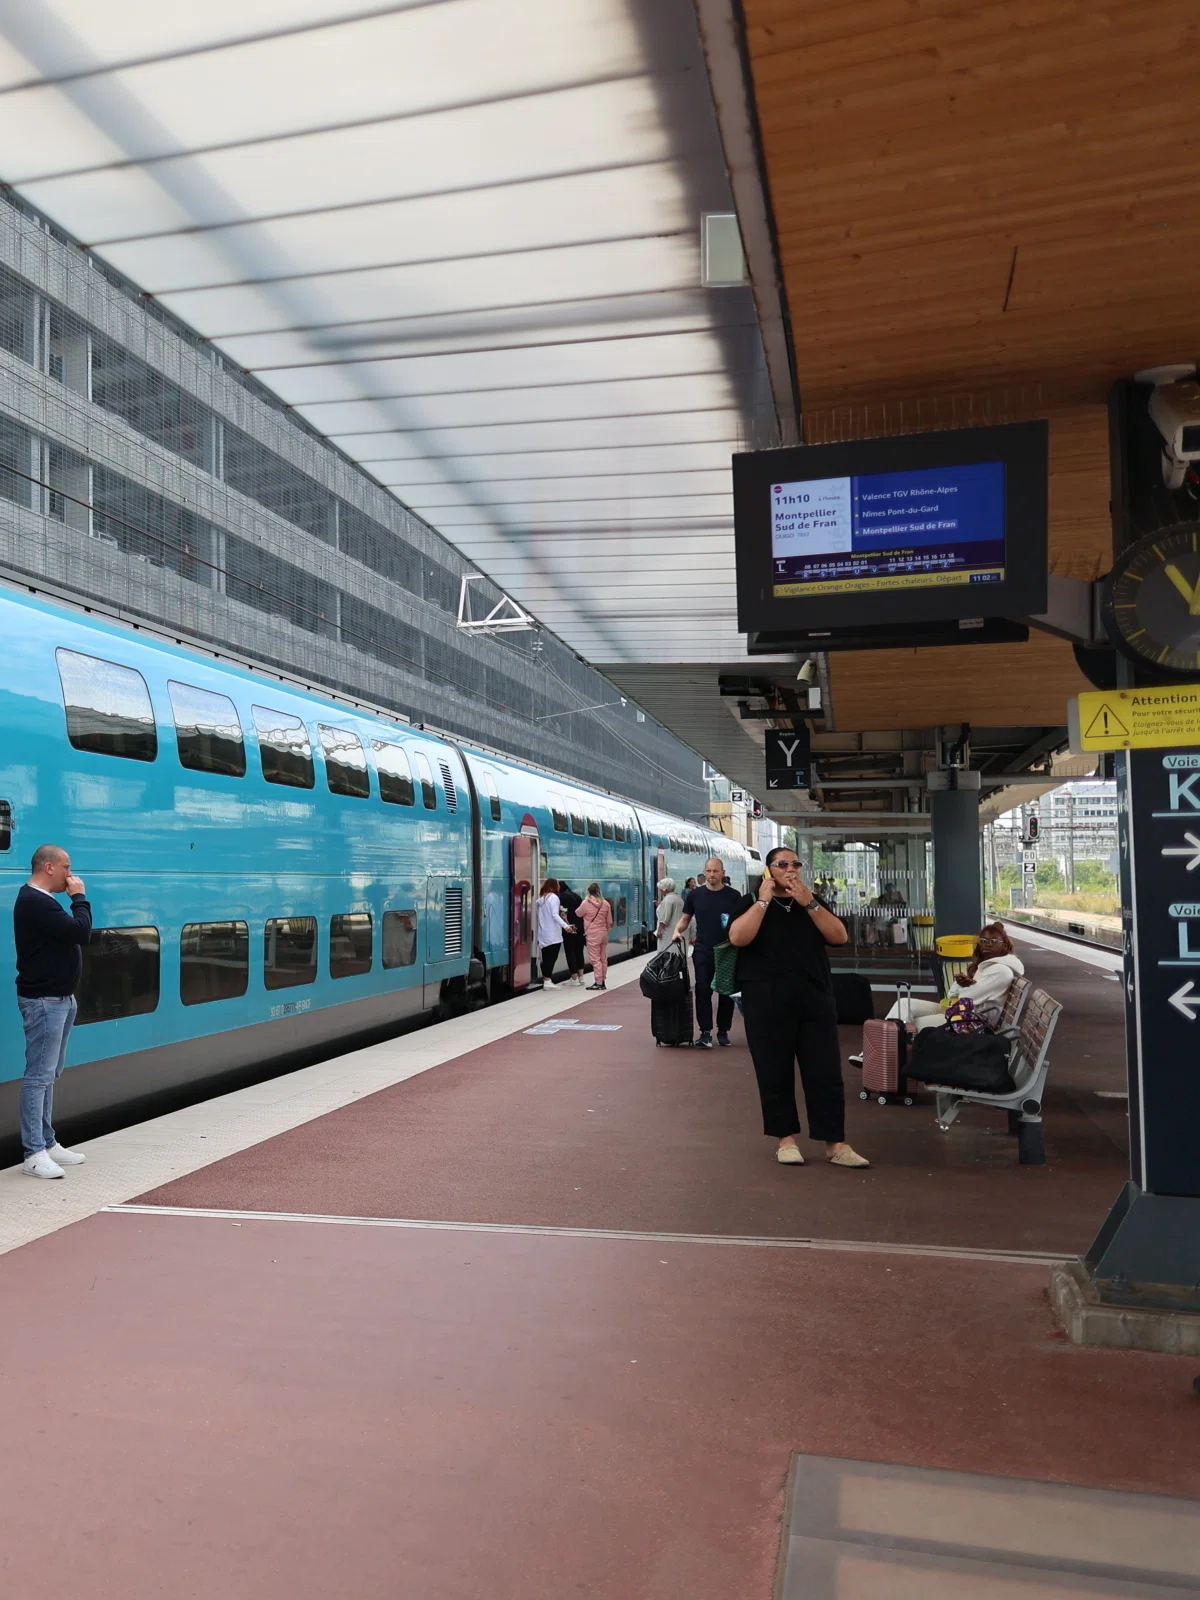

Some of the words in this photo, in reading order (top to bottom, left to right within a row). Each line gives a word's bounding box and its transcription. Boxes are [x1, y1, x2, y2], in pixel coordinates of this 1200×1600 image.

[910, 486, 958, 496] Rhône-Alpes
[775, 494, 810, 505] 11h10
[775, 508, 837, 520] Montpellier
[862, 510, 886, 518] Nîmes
[888, 504, 939, 516] Pont-du-Gard
[775, 522, 795, 532] Sud
[798, 522, 810, 530] de
[813, 520, 837, 528] Fran
[862, 526, 908, 535] Montpellier
[910, 523, 925, 531] Sud
[938, 520, 956, 528] Fran
[778, 564, 785, 572] L
[784, 586, 816, 594] Vigilance
[936, 575, 962, 584] Départ
[1132, 694, 1198, 706] Attention
[1132, 728, 1160, 737] jusqu'à
[777, 740, 800, 766] Y
[1168, 756, 1198, 767] Voie
[797, 776, 804, 785] L
[1169, 773, 1200, 810] K
[1178, 922, 1200, 958] L
